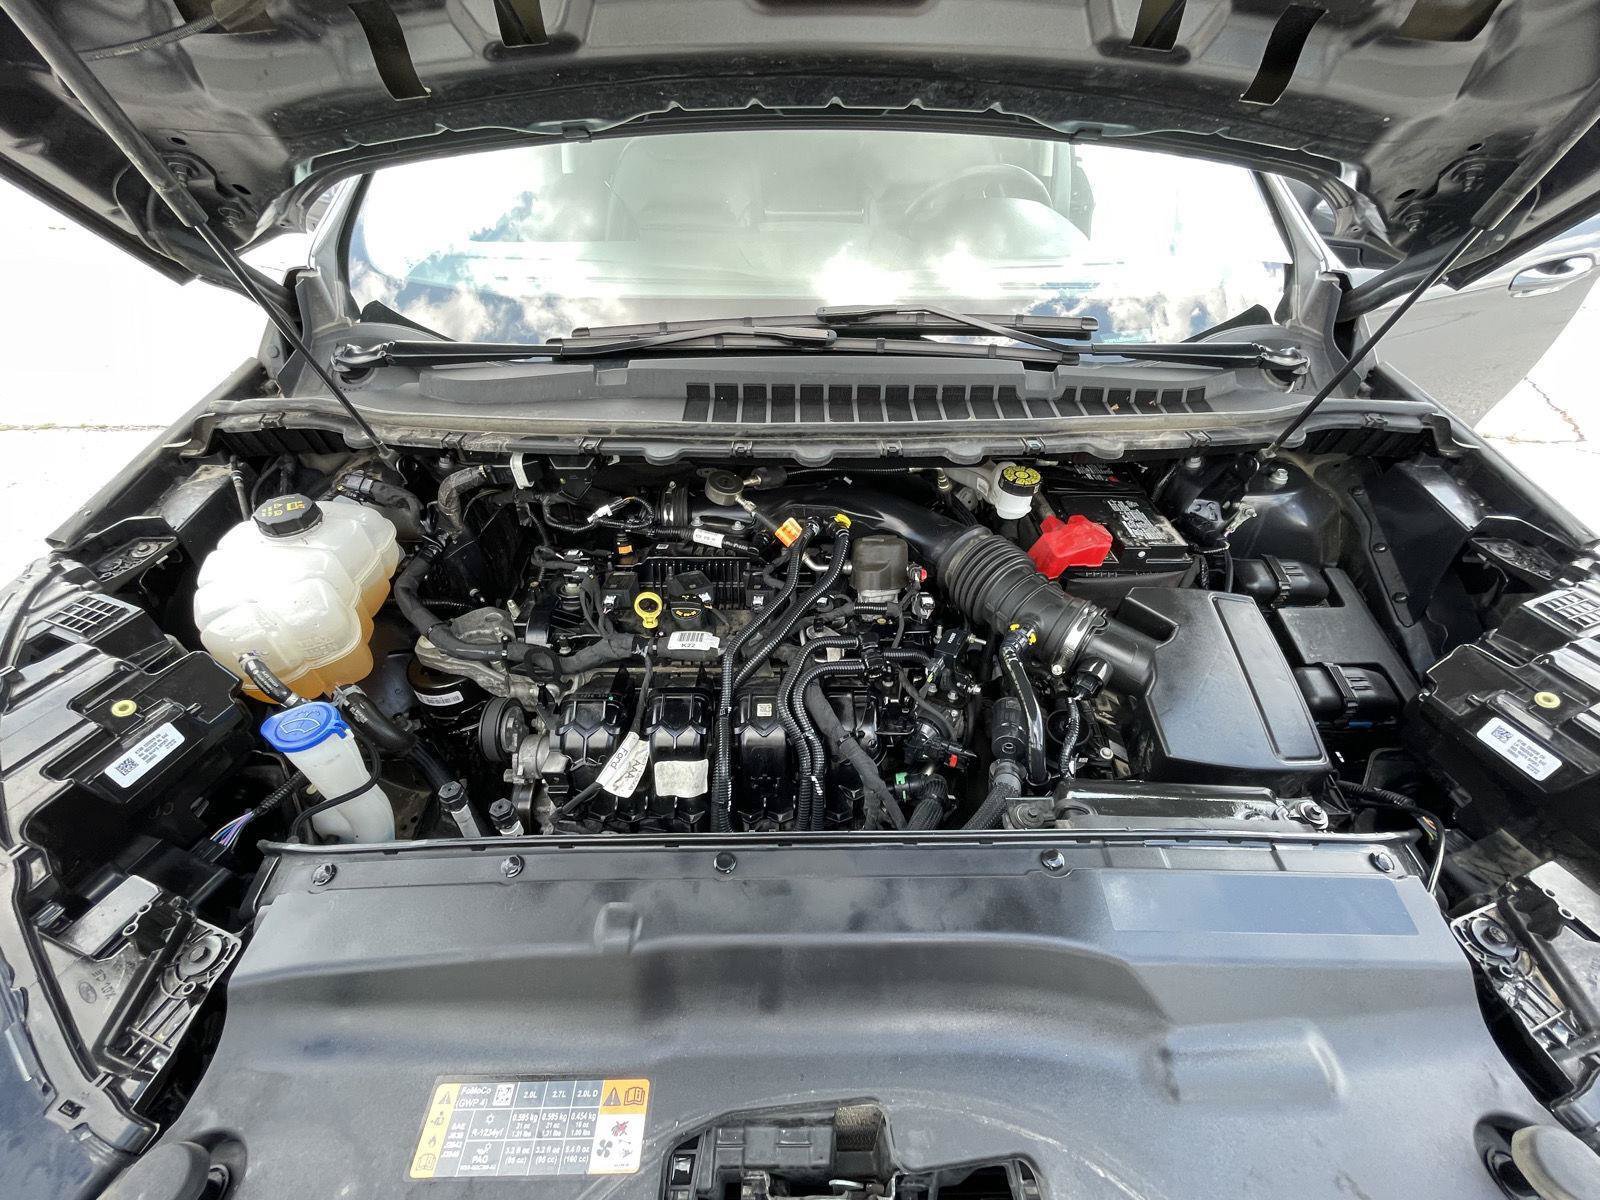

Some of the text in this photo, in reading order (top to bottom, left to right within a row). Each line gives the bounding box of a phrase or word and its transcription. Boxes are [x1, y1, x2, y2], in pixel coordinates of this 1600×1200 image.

[610, 747, 628, 769] Ford
[461, 1086, 491, 1095] FoMoCo
[523, 1091, 537, 1099] 2.0L
[577, 1090, 591, 1098] 2.0L
[455, 1099, 478, 1109] (GWP
[530, 1113, 538, 1123] kg
[559, 1112, 567, 1122] kg
[570, 1112, 596, 1121] 0.454 kg
[471, 1127, 504, 1138] R-1234yf
[472, 1155, 488, 1163] PAG
[578, 1155, 588, 1164] cc)
